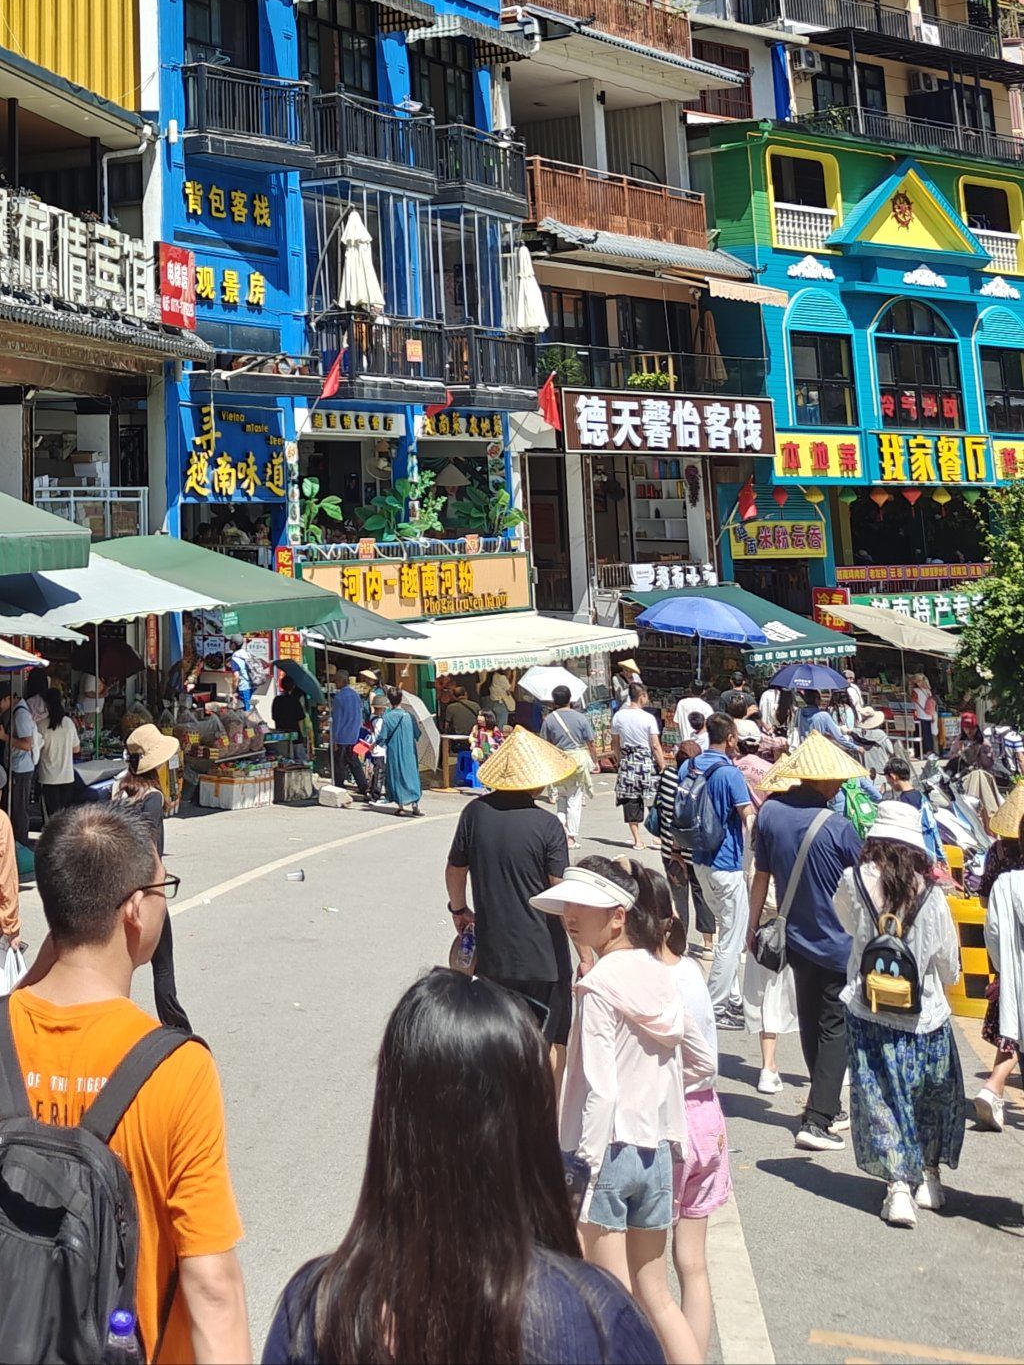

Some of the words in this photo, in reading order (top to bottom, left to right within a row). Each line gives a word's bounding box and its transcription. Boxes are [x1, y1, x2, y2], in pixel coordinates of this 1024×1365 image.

[184, 181, 271, 227] 背包客栈
[196, 266, 265, 305] 观景房
[576, 395, 762, 451] 德天馨怡客栈
[185, 451, 285, 497] 越南味道
[781, 441, 858, 471] 本地菜
[879, 434, 987, 482] 我家餐厅
[759, 524, 823, 549] 米粉云吞
[27, 1071, 40, 1088] OF
